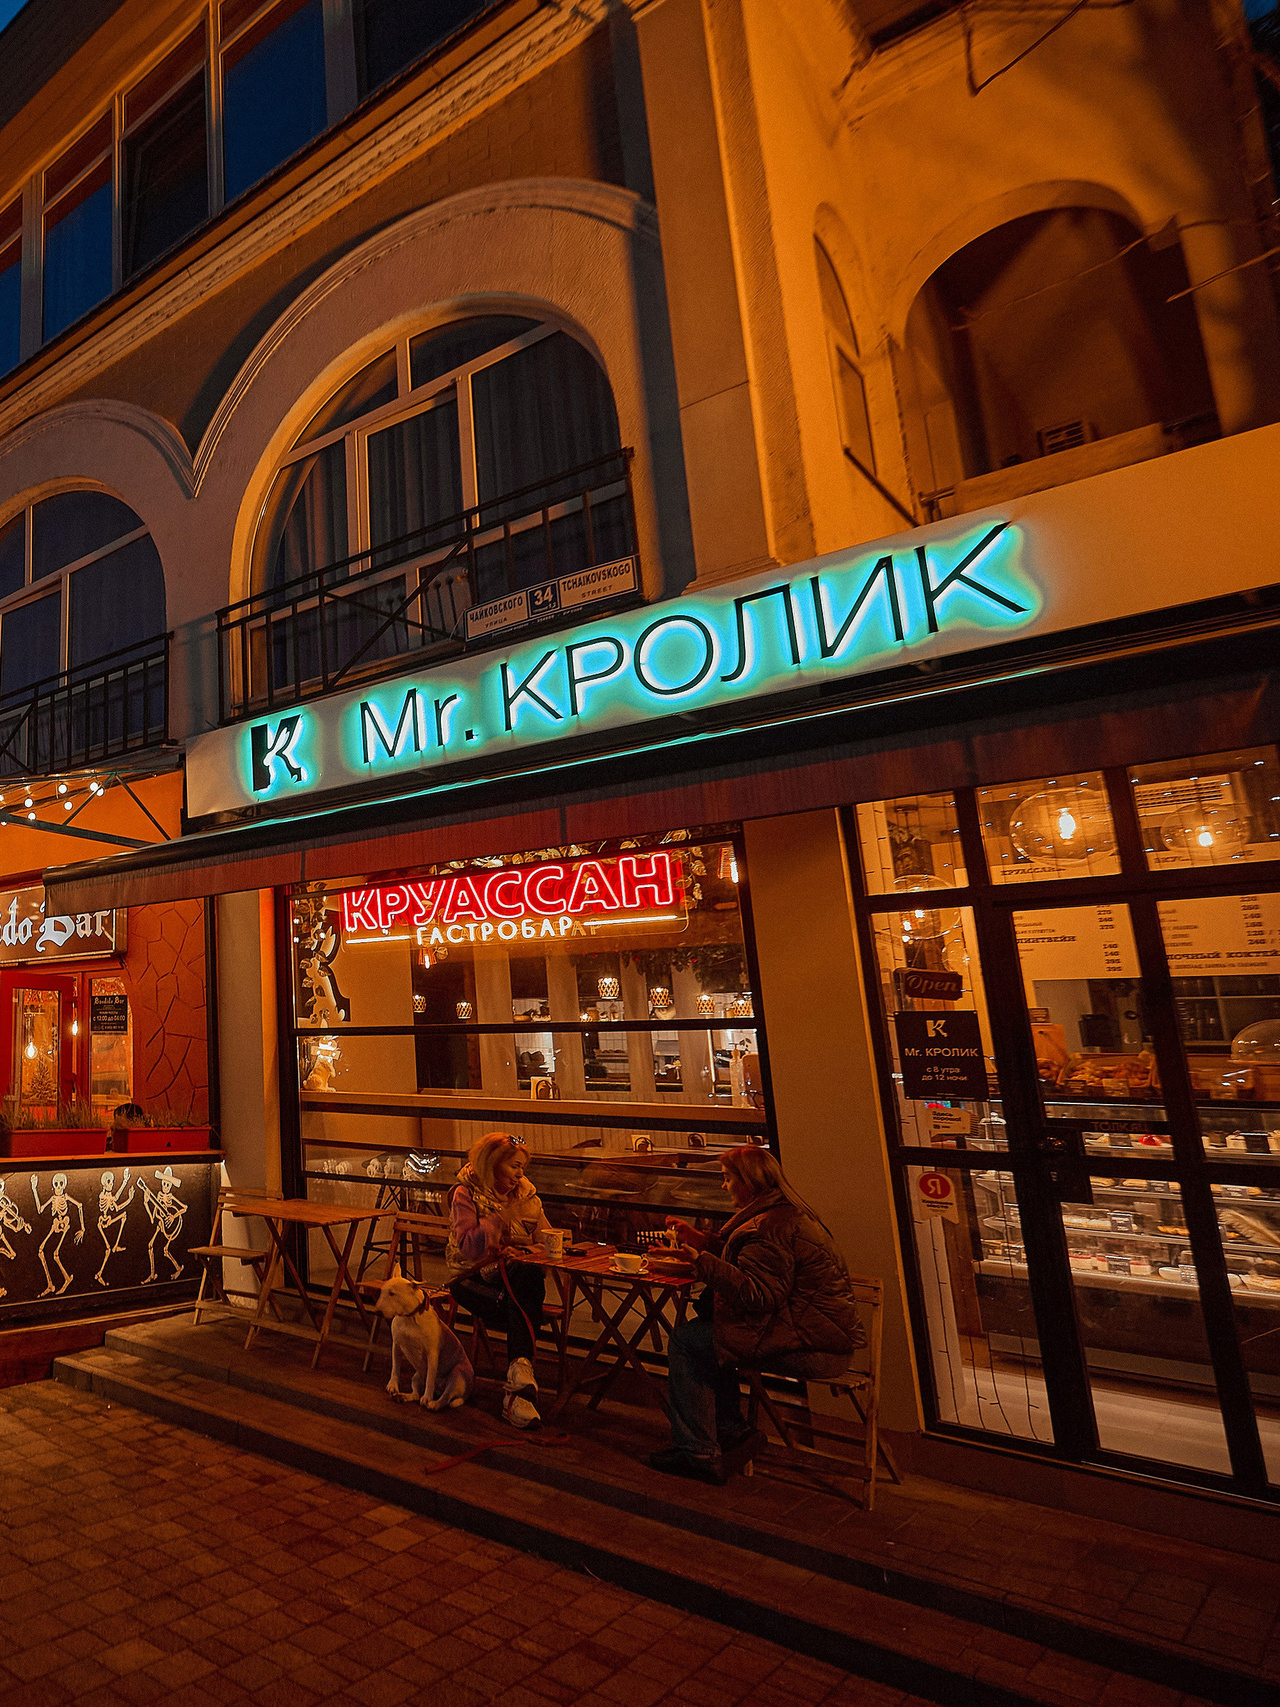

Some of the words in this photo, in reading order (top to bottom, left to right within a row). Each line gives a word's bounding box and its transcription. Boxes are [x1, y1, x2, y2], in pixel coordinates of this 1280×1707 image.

[561, 562, 631, 592] TCHAIKOVSKOGO
[533, 585, 554, 606] 34
[581, 585, 613, 599] STREET
[469, 595, 524, 623] ЧАЙКОВСКОГО
[484, 616, 508, 628] УЛИЦА
[359, 687, 476, 764] Mr.
[499, 520, 1031, 732] КРОЛИК
[342, 851, 675, 932] КРУАССАН
[416, 916, 572, 945] ГАСТРОБАР
[1015, 934, 1077, 944] ЛИНТВЕЙН
[1166, 950, 1222, 960] ЛОЧНЫЙ
[907, 975, 958, 993] Open
[904, 1048, 922, 1057] Mr.
[925, 1048, 979, 1057] КРОЛИК
[927, 1178, 942, 1195] Я
